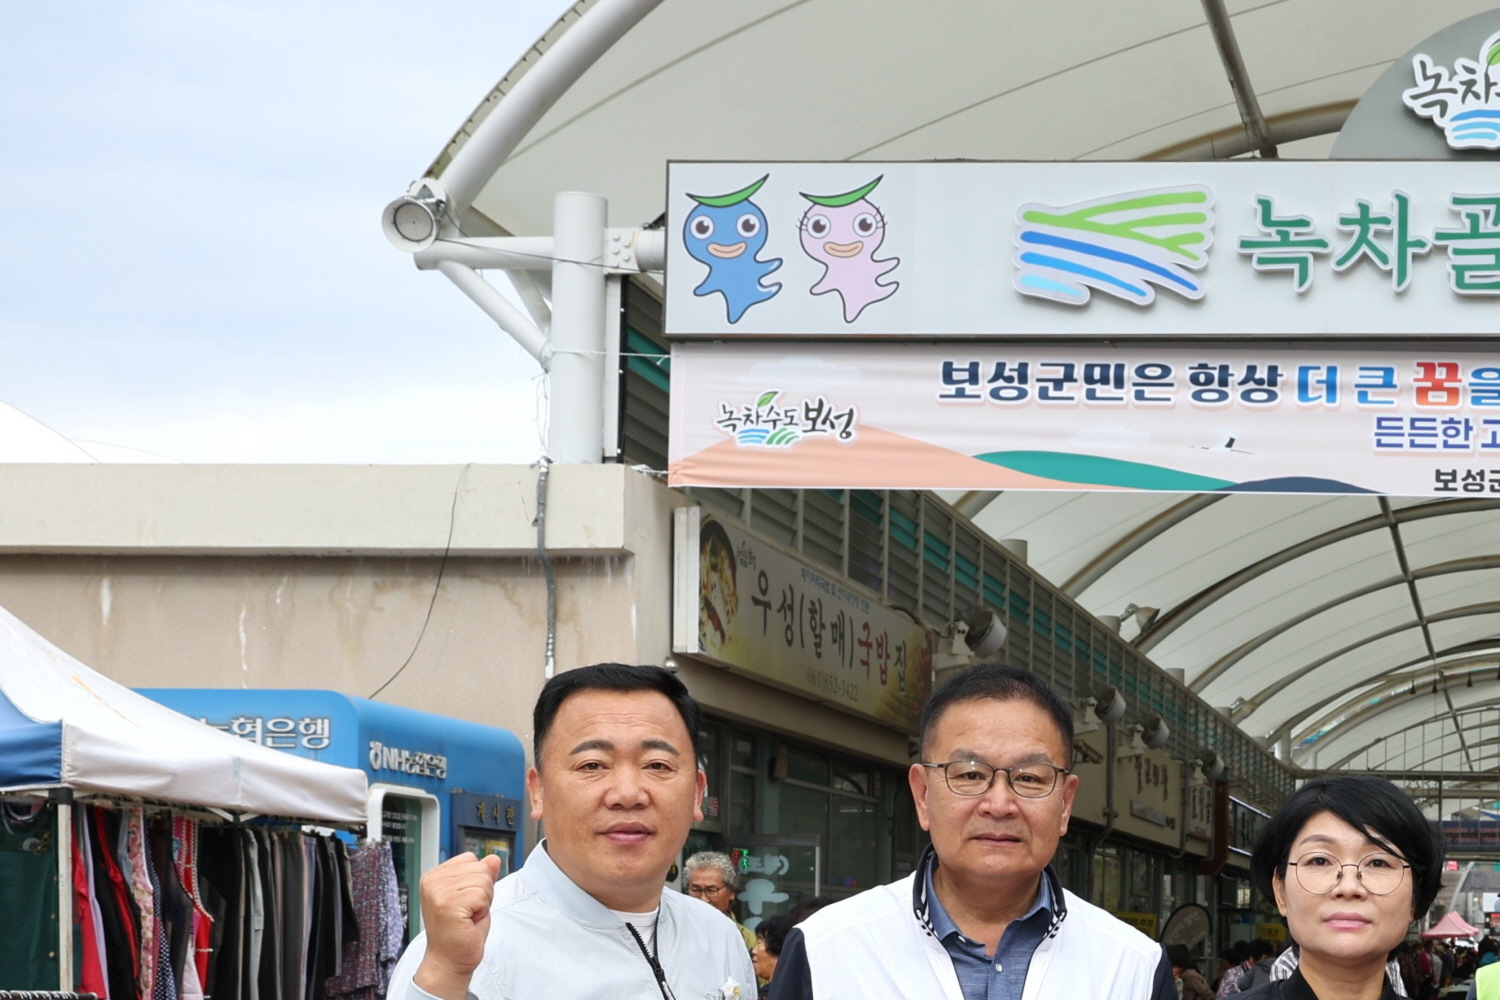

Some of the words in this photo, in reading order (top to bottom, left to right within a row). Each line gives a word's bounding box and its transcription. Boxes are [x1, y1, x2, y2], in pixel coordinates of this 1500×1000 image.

[938, 361, 1177, 403] 보성군민은
[1188, 363, 1283, 405] 항상
[1297, 365, 1340, 405] 더
[1354, 366, 1399, 406] 큰
[1374, 416, 1475, 451] 든든한
[200, 717, 331, 749] 협은행
